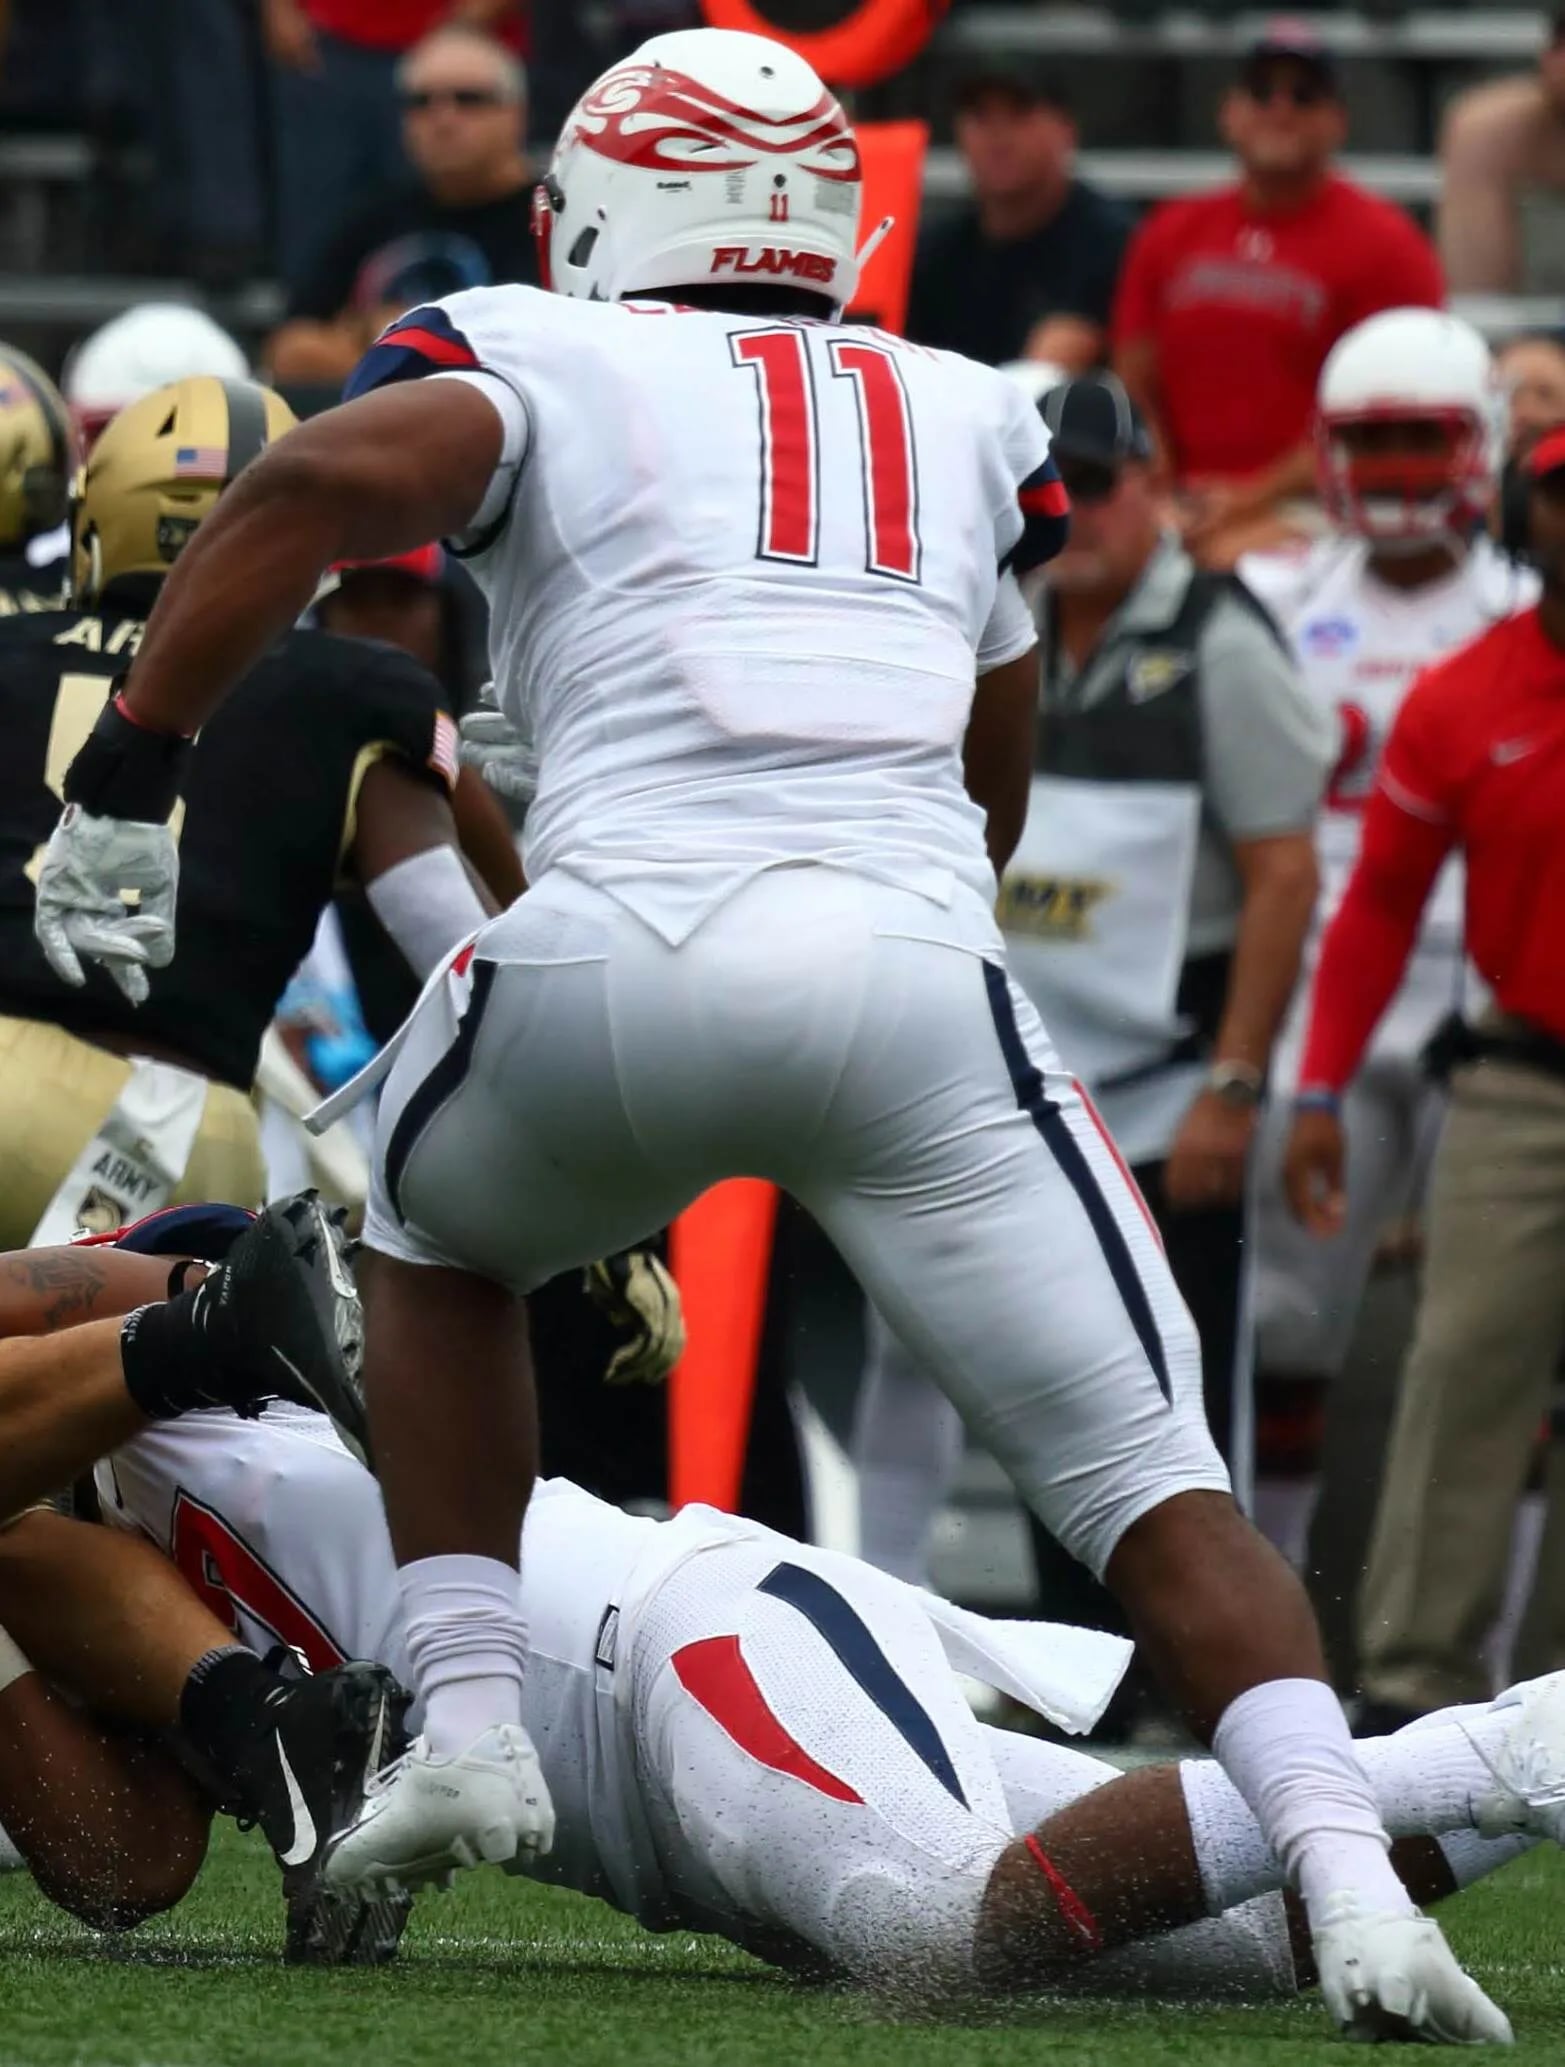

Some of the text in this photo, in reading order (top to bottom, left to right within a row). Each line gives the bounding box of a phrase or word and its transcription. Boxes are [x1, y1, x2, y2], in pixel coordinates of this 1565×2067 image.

[768, 193, 789, 222] 11
[710, 247, 838, 284] FLAMES
[727, 326, 923, 585] 11
[92, 1151, 161, 1201] ARMY
